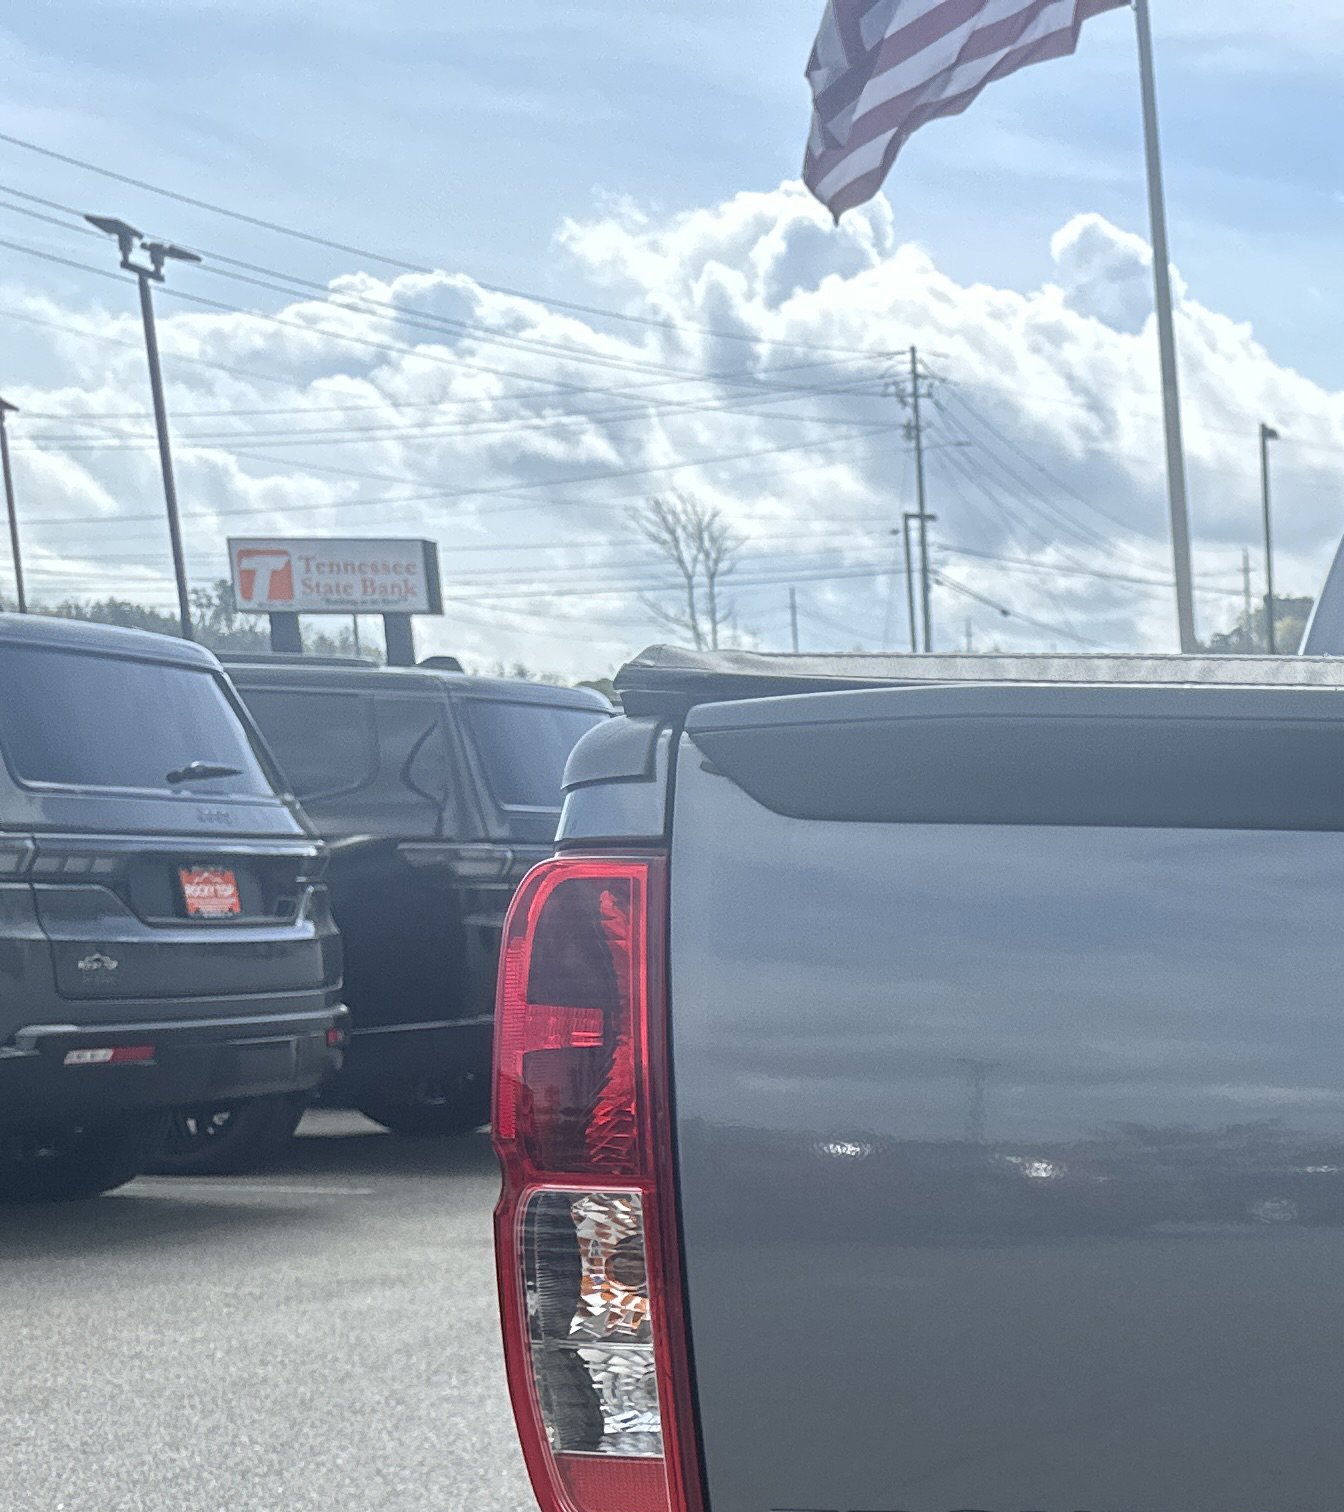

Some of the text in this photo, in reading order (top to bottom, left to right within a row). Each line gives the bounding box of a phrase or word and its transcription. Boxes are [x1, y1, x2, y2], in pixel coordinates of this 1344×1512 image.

[298, 555, 417, 576] Tennessee
[301, 577, 418, 597] State Bank
